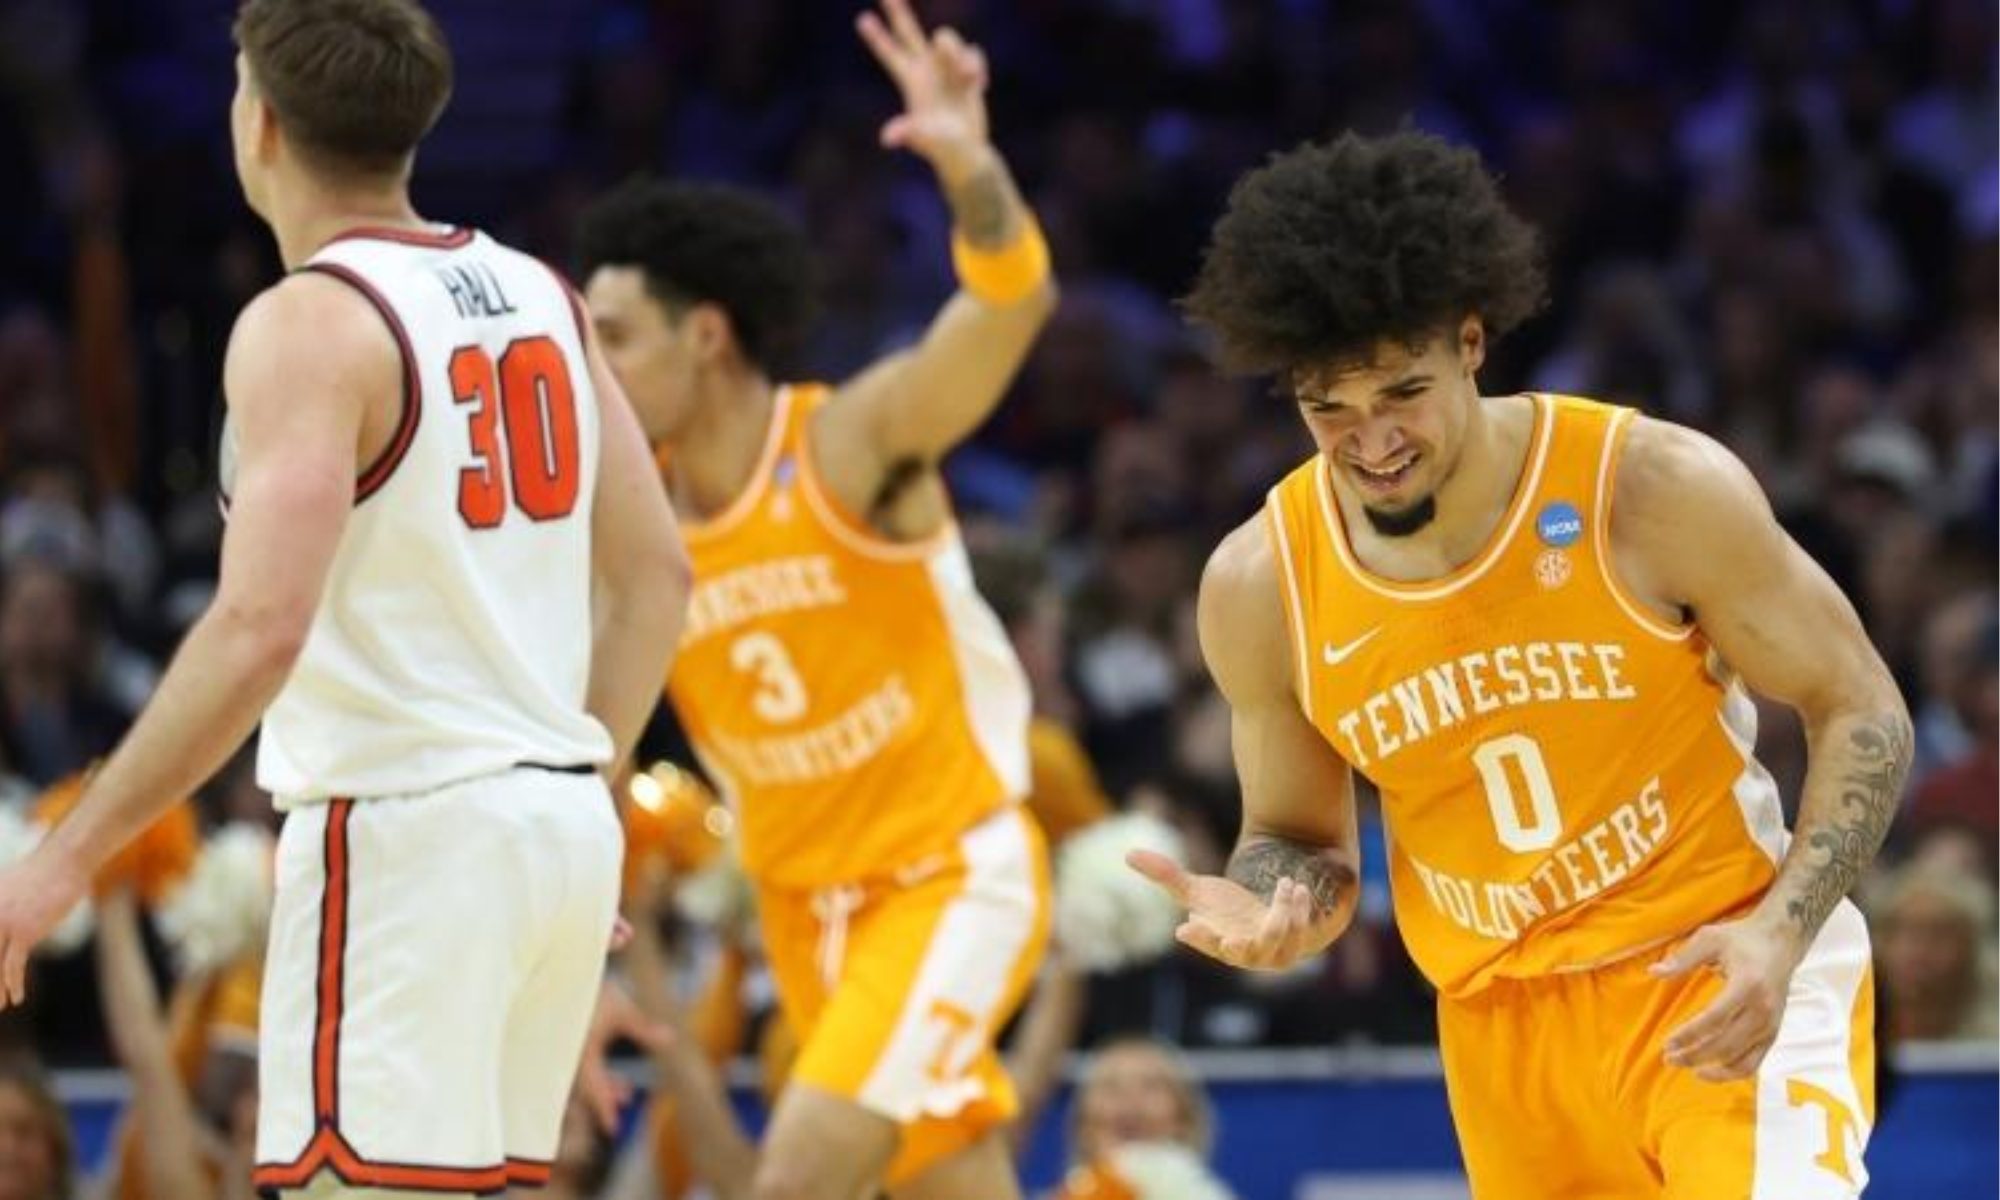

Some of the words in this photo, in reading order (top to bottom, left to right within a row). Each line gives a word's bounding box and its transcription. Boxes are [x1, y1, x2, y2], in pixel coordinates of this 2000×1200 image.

[439, 261, 517, 320] HALL
[448, 335, 580, 530] 30
[1543, 518, 1581, 538] NCAA
[731, 631, 808, 724] 3
[1337, 641, 1637, 767] TENNESSEE
[1472, 733, 1563, 854] 0
[1409, 775, 1669, 941] VOLUNTEERS
[1786, 1077, 1858, 1187] T
